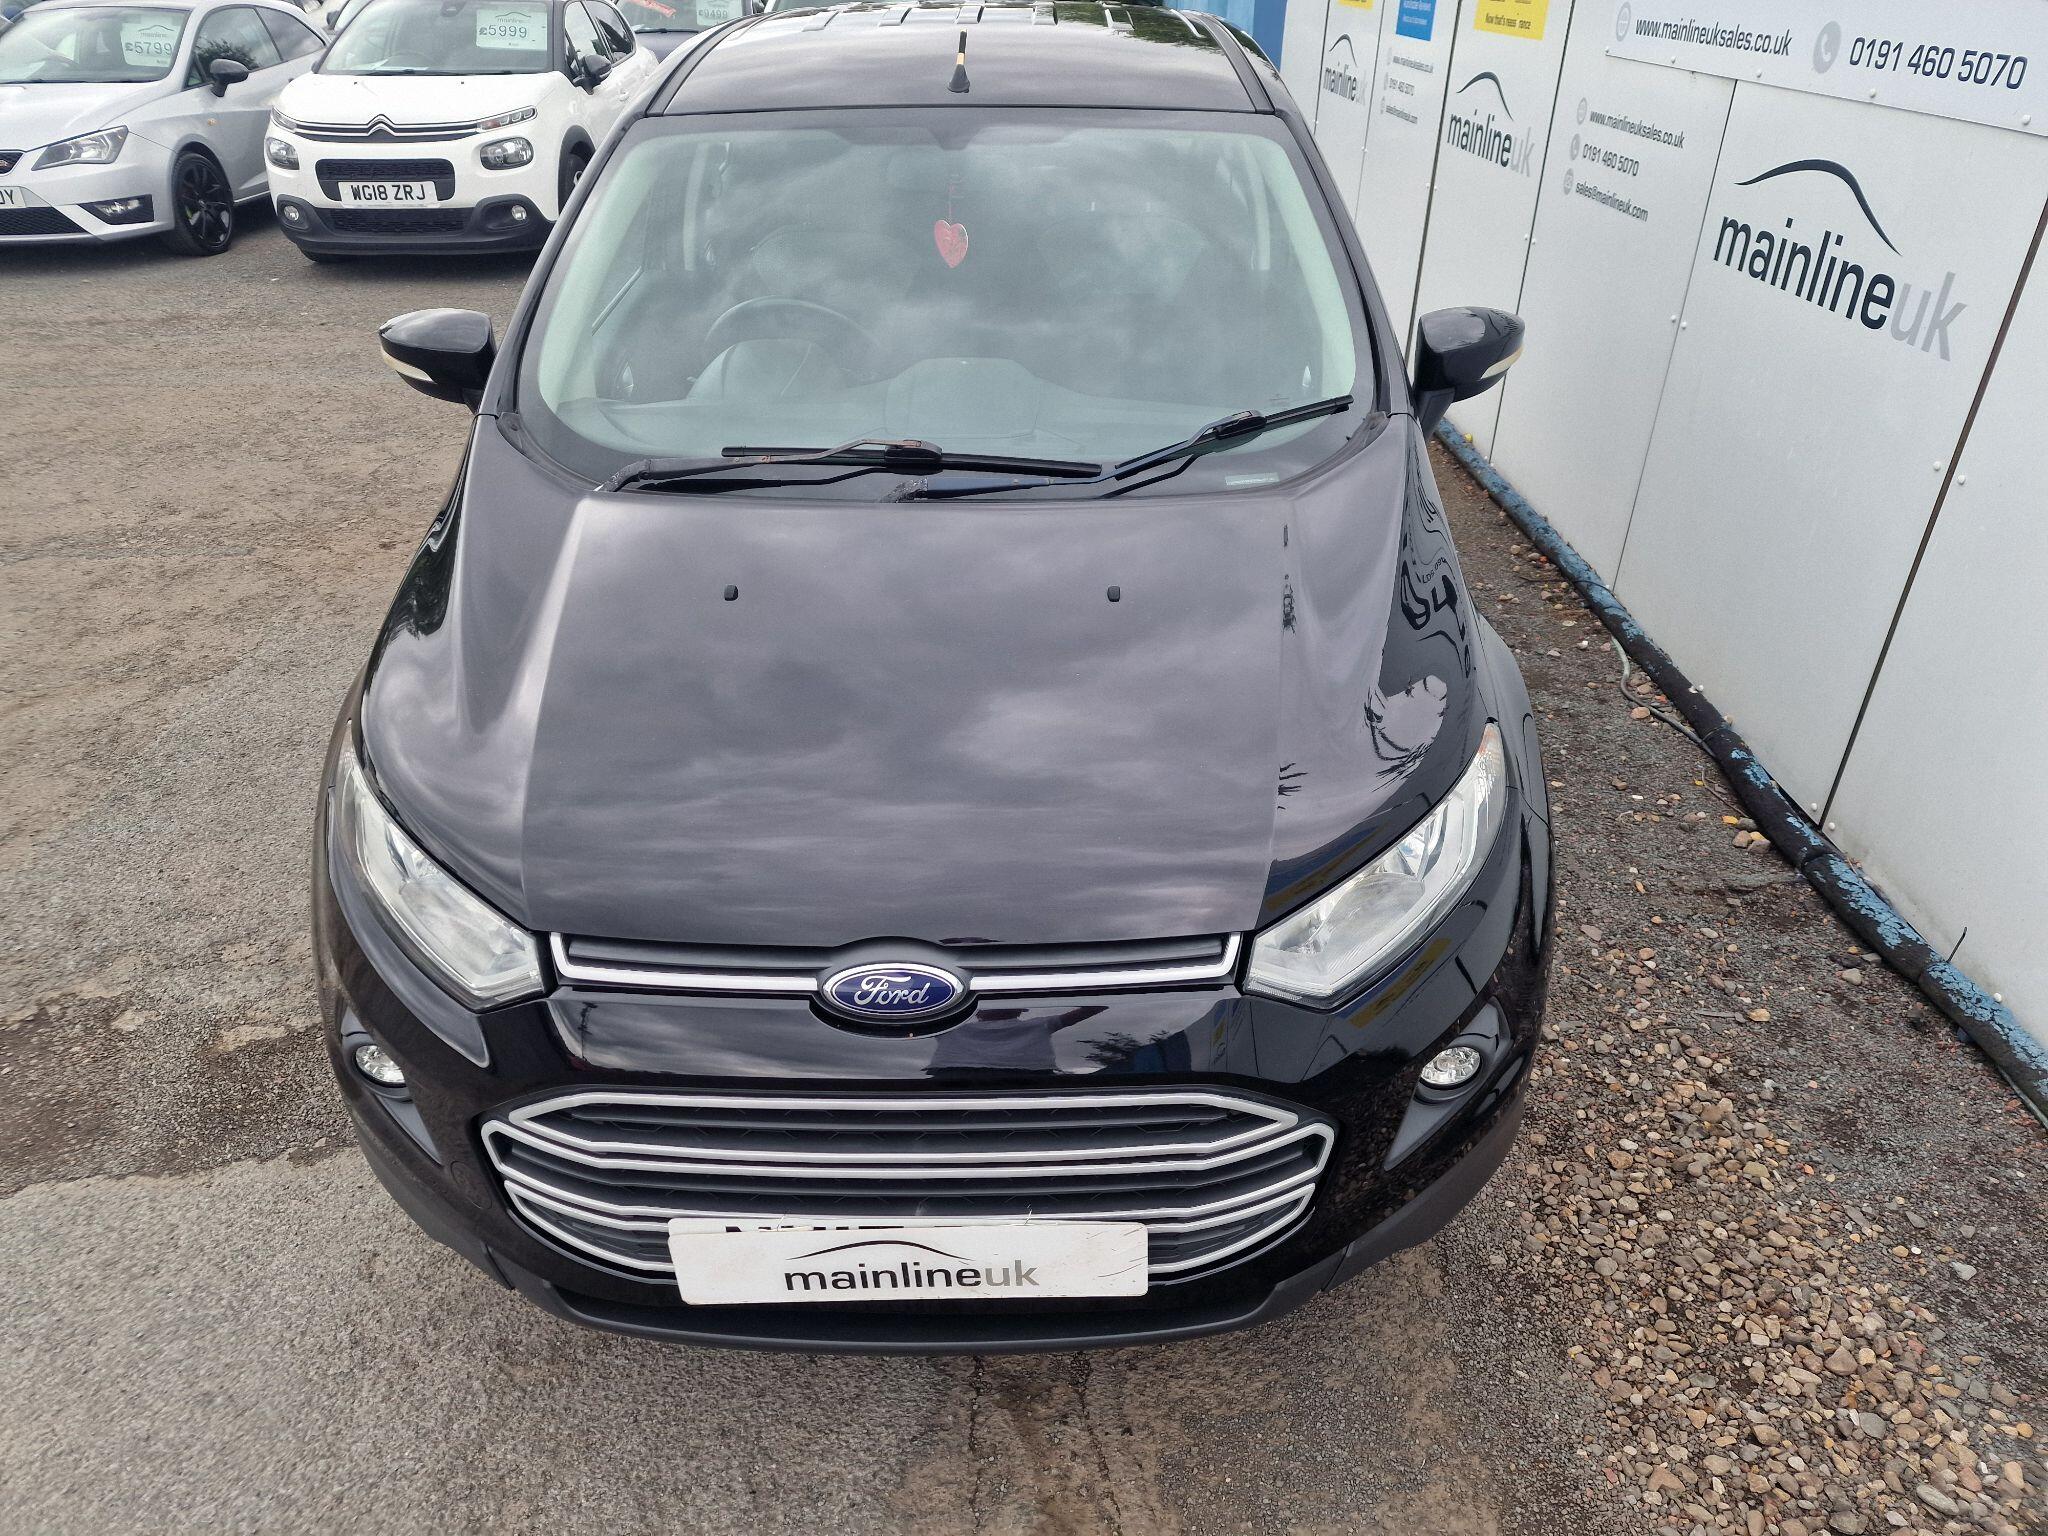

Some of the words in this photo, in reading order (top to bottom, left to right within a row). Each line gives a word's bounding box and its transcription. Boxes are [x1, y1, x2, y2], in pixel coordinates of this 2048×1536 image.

[125, 41, 173, 55] £5799
[479, 25, 527, 38] £5999
[1635, 16, 1792, 57] www.mainlineuksales.co.uk
[1849, 37, 1904, 72] 0191
[1906, 44, 1956, 79] 460
[1957, 50, 2028, 90] 5070
[1447, 109, 1535, 177] mainlineuk
[1590, 110, 1685, 149] www.mainlineuksales.co.uk
[1582, 143, 1601, 163] 0191
[1602, 151, 1618, 169] 460
[1617, 156, 1640, 177] 5070
[350, 184, 388, 200] WG18
[391, 184, 426, 200] ZRJ
[1575, 180, 1649, 222] sales@mainlineuk.com
[1713, 215, 1967, 362] mainlineuk
[854, 975, 931, 1006] Ford
[784, 1259, 1040, 1292] mainlineuk
